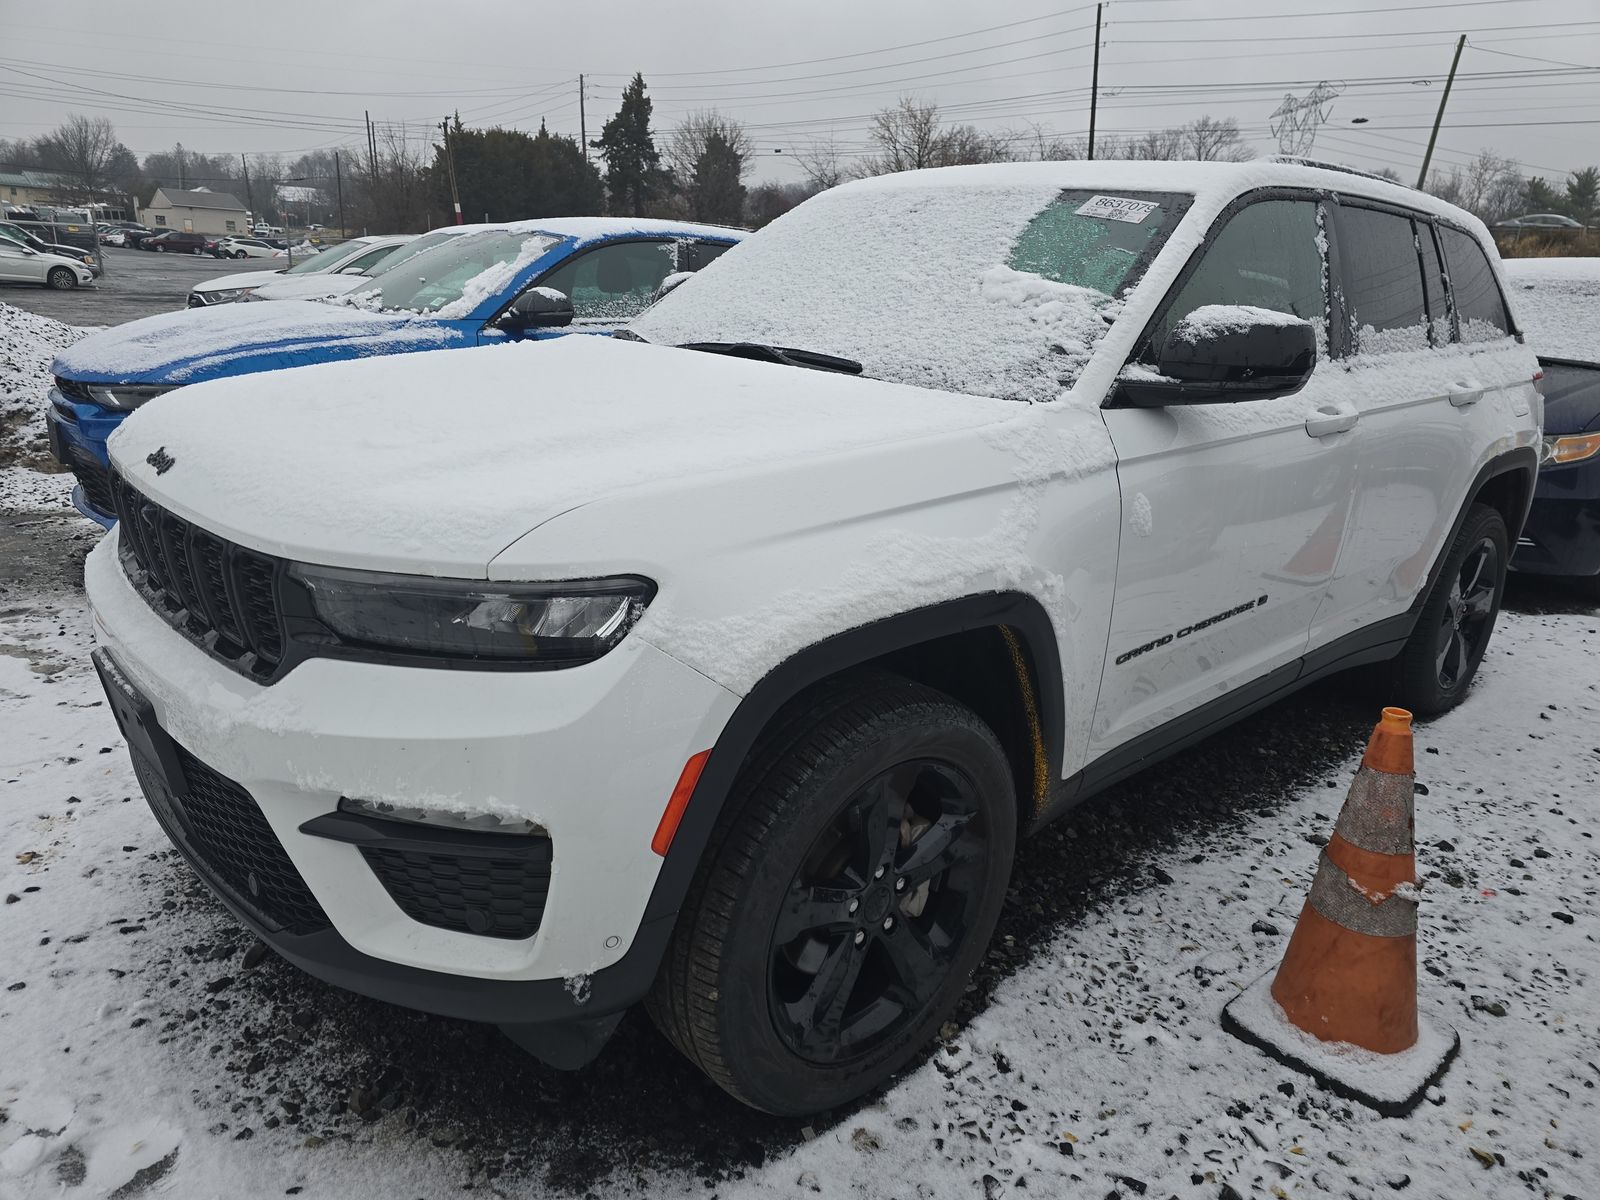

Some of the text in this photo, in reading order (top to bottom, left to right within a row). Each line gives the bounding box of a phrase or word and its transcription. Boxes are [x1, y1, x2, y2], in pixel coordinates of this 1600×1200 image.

[1095, 198, 1157, 213] 8637079
[1115, 600, 1256, 665] GRAND CHEROKEE
